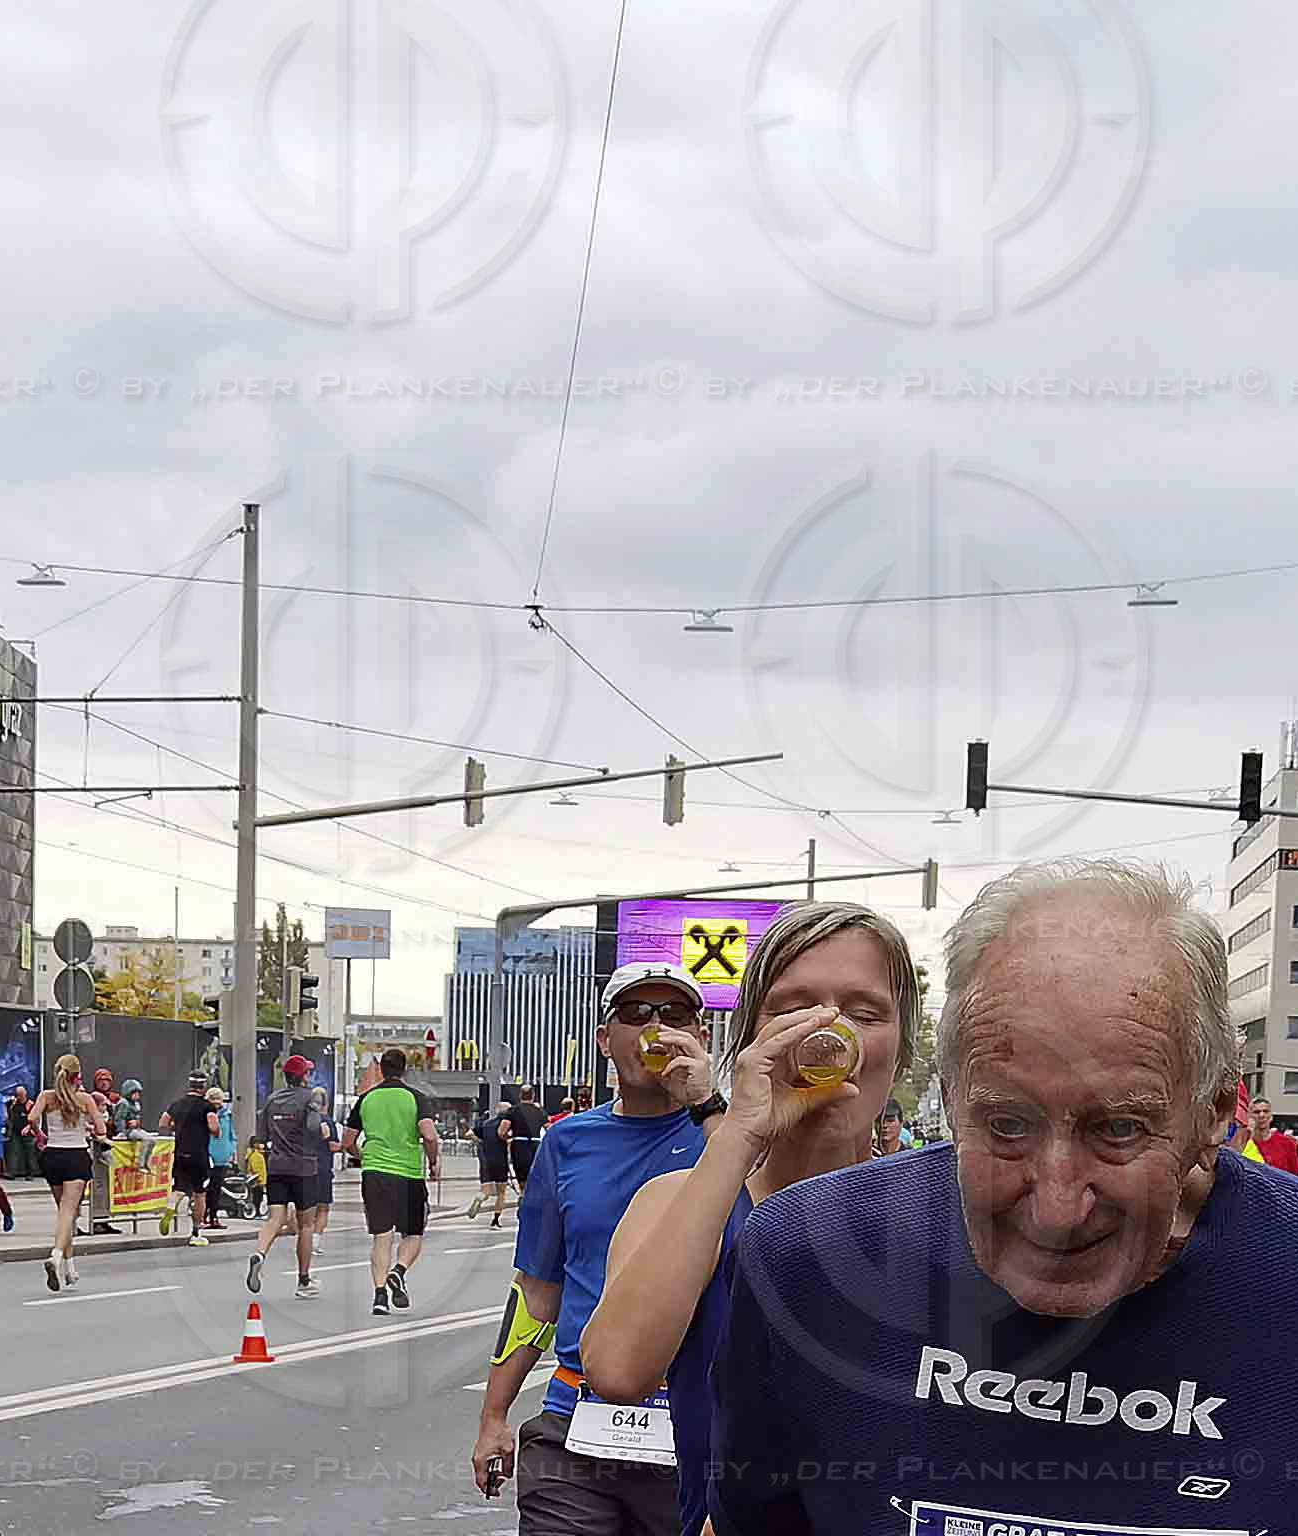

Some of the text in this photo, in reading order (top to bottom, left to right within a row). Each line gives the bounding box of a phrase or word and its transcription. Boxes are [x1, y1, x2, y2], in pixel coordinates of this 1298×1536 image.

[915, 1345, 1228, 1440] Reebok
[611, 1410, 651, 1430] 644
[947, 1518, 982, 1531] KLEINE
